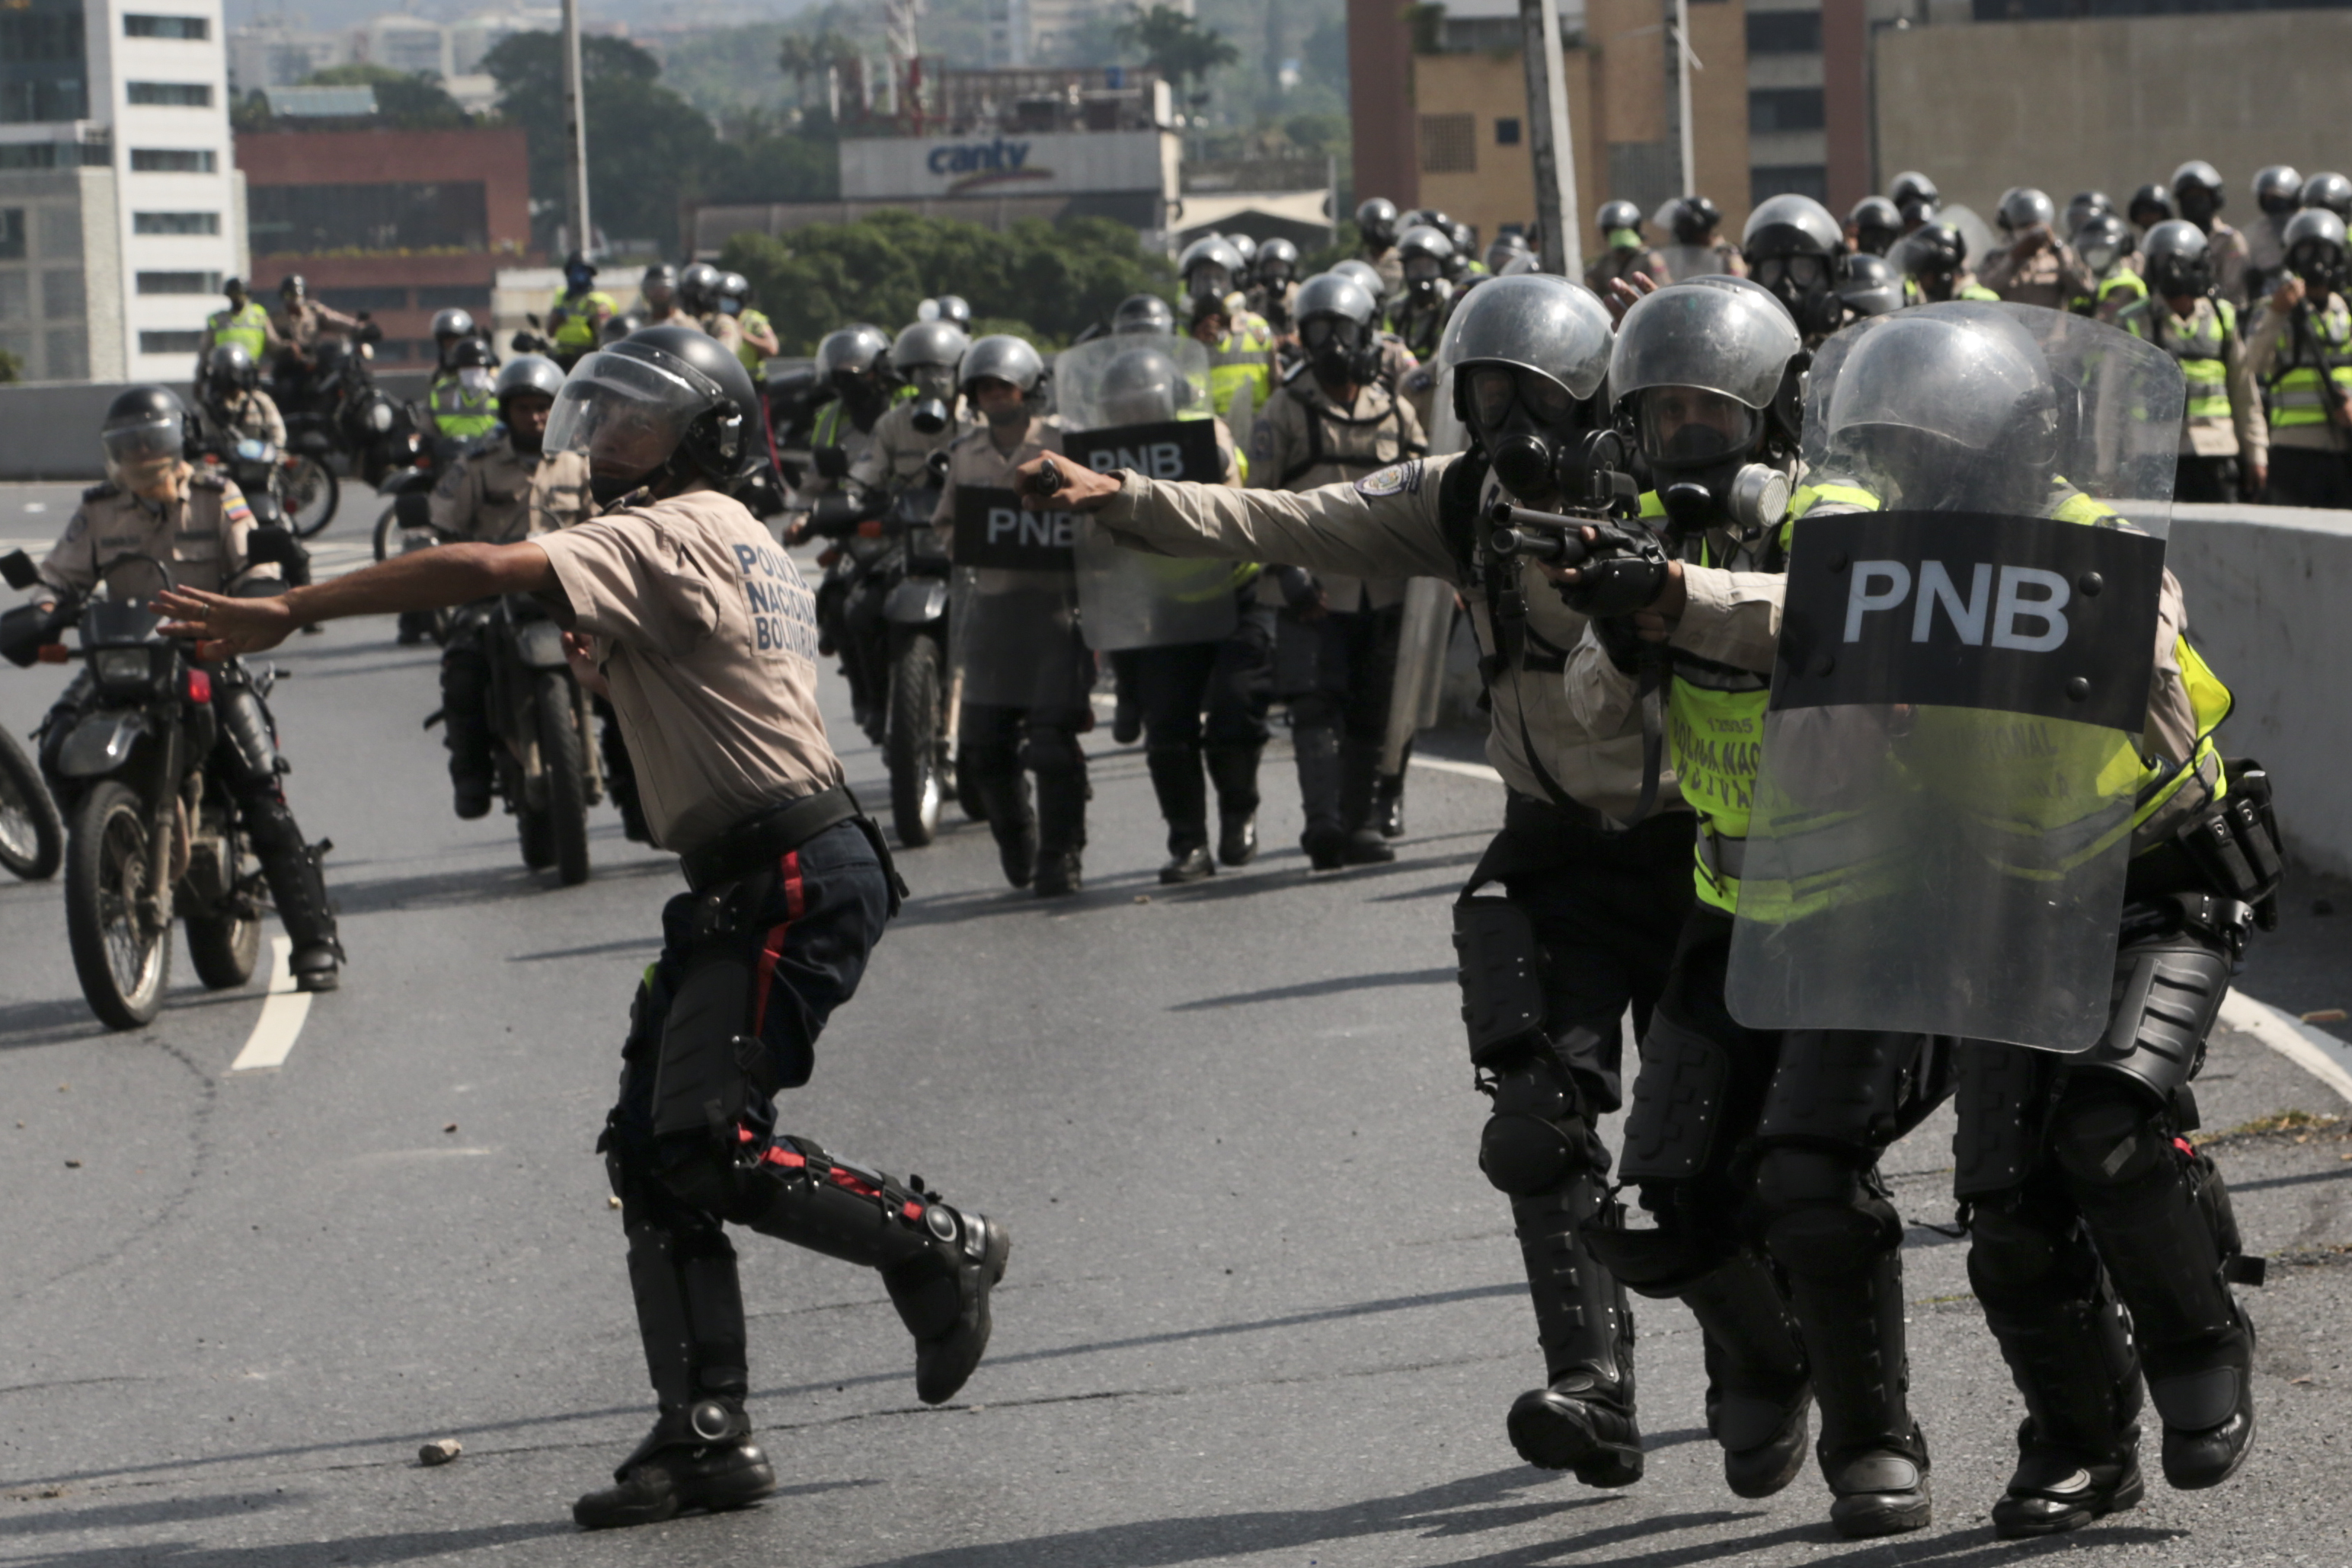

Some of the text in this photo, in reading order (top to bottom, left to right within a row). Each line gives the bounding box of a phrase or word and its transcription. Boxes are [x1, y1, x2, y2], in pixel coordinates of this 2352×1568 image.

[928, 136, 1032, 175] cantv
[1088, 442, 1184, 481] PNB
[987, 507, 1076, 548] PNB
[1843, 560, 2071, 653] PNB
